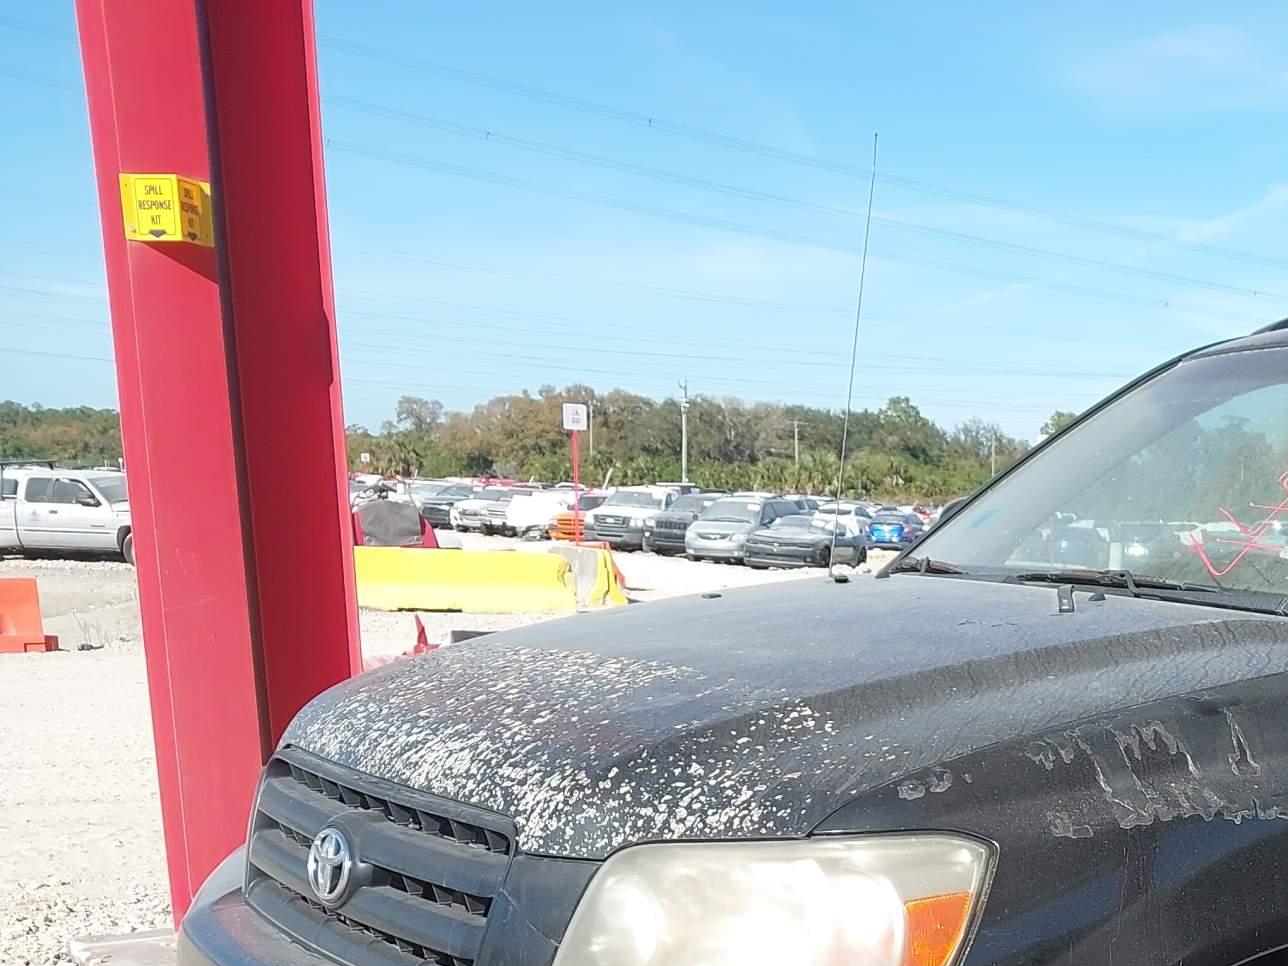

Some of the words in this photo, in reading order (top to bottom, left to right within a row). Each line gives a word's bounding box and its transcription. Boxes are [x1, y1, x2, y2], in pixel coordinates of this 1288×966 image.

[144, 184, 163, 196] SPILL
[138, 199, 172, 211] RESPONSE
[151, 214, 162, 225] KIT
